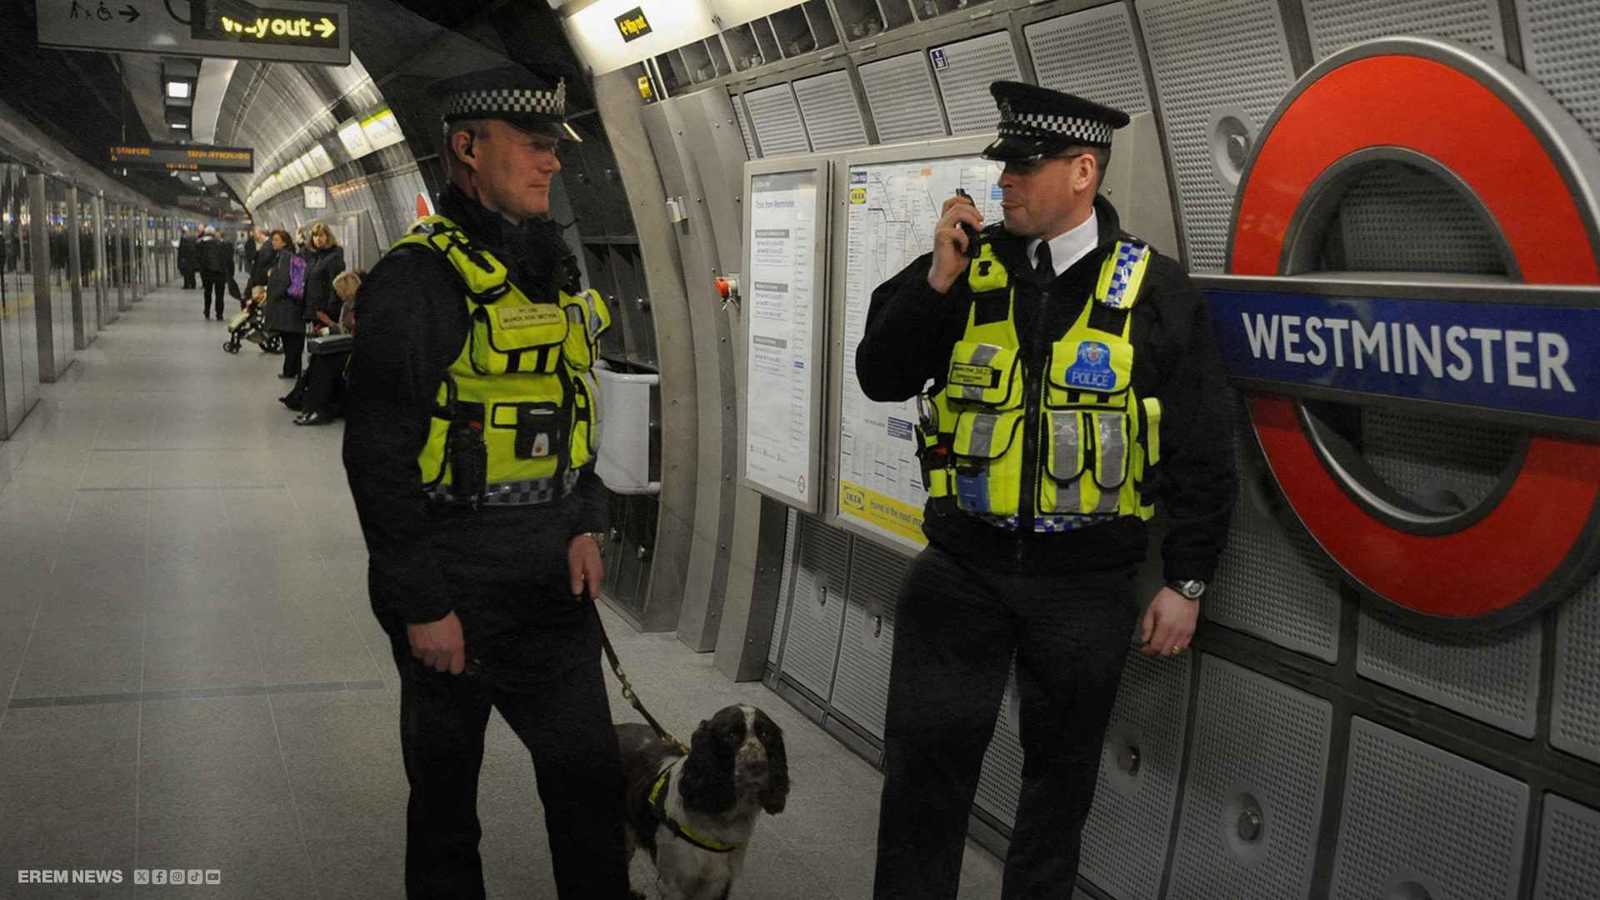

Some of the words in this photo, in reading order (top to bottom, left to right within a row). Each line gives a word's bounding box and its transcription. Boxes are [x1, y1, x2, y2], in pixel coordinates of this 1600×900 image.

[271, 18, 312, 37] out
[1241, 312, 1577, 393] WESTMINSTER
[1071, 370, 1109, 387] POLICE
